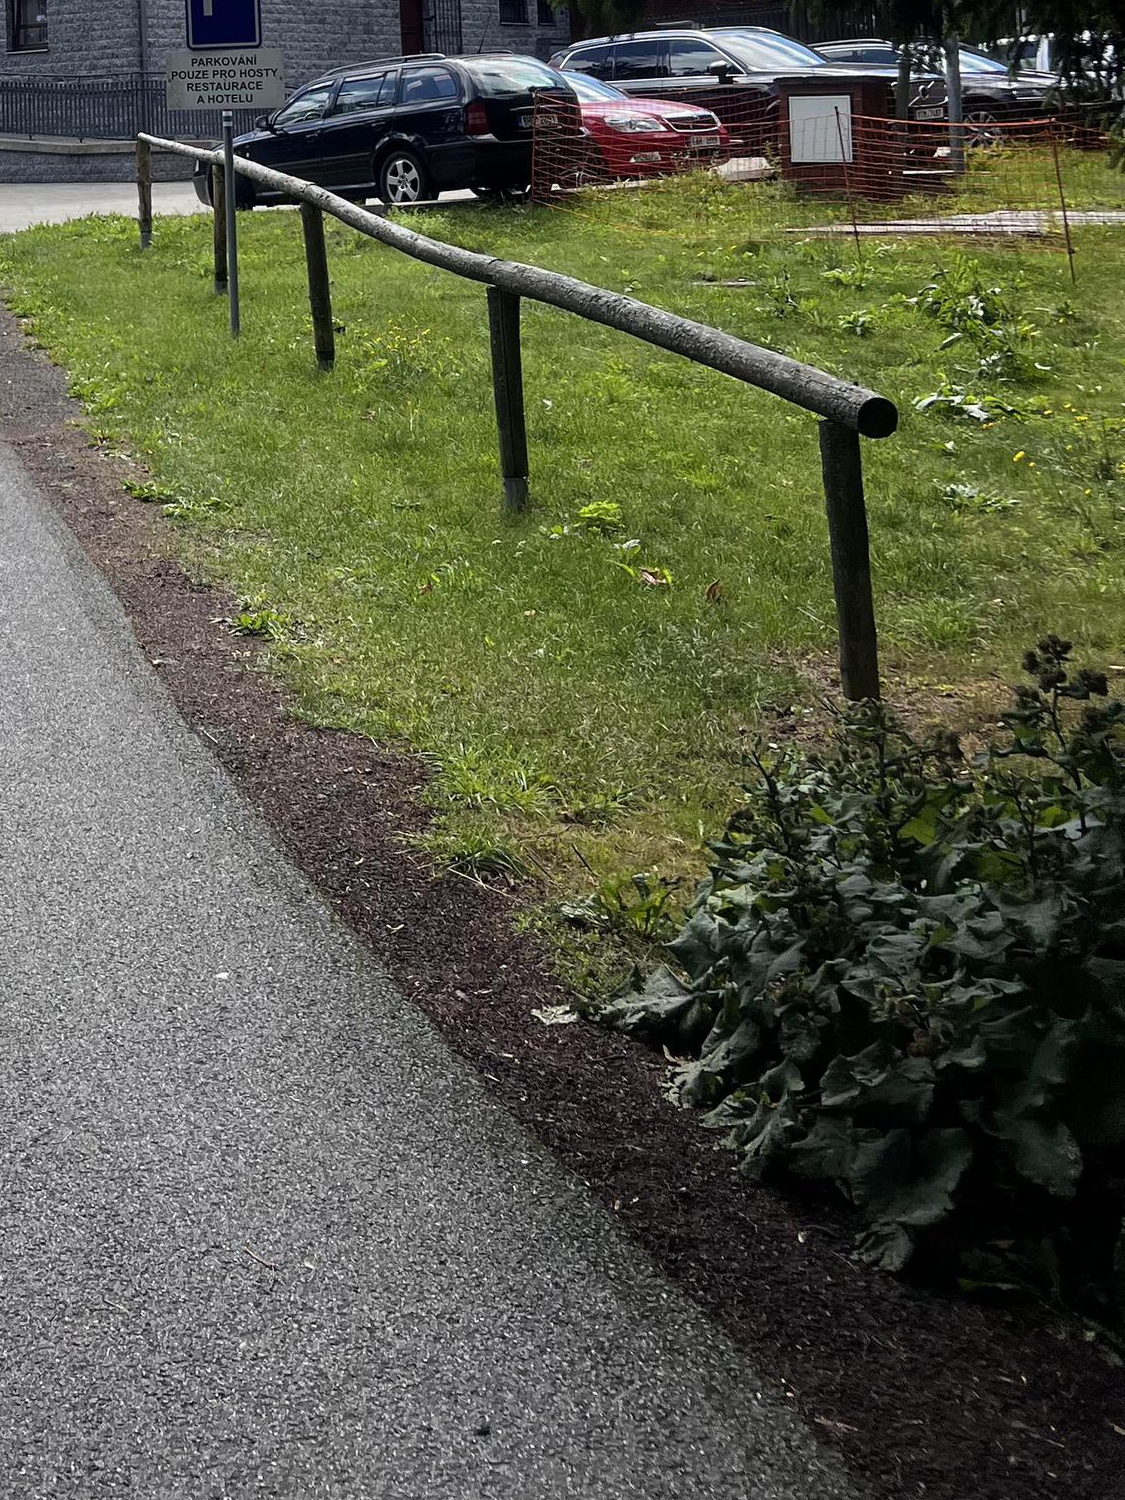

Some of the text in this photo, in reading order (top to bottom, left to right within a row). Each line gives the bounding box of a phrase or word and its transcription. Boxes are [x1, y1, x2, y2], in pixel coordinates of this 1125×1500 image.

[191, 54, 257, 67] PARKOVÁNÍ
[171, 68, 278, 80] POUZE PRO HOSTY
[187, 81, 263, 92] RESTAURACE
[196, 94, 253, 104] A HOTELU
